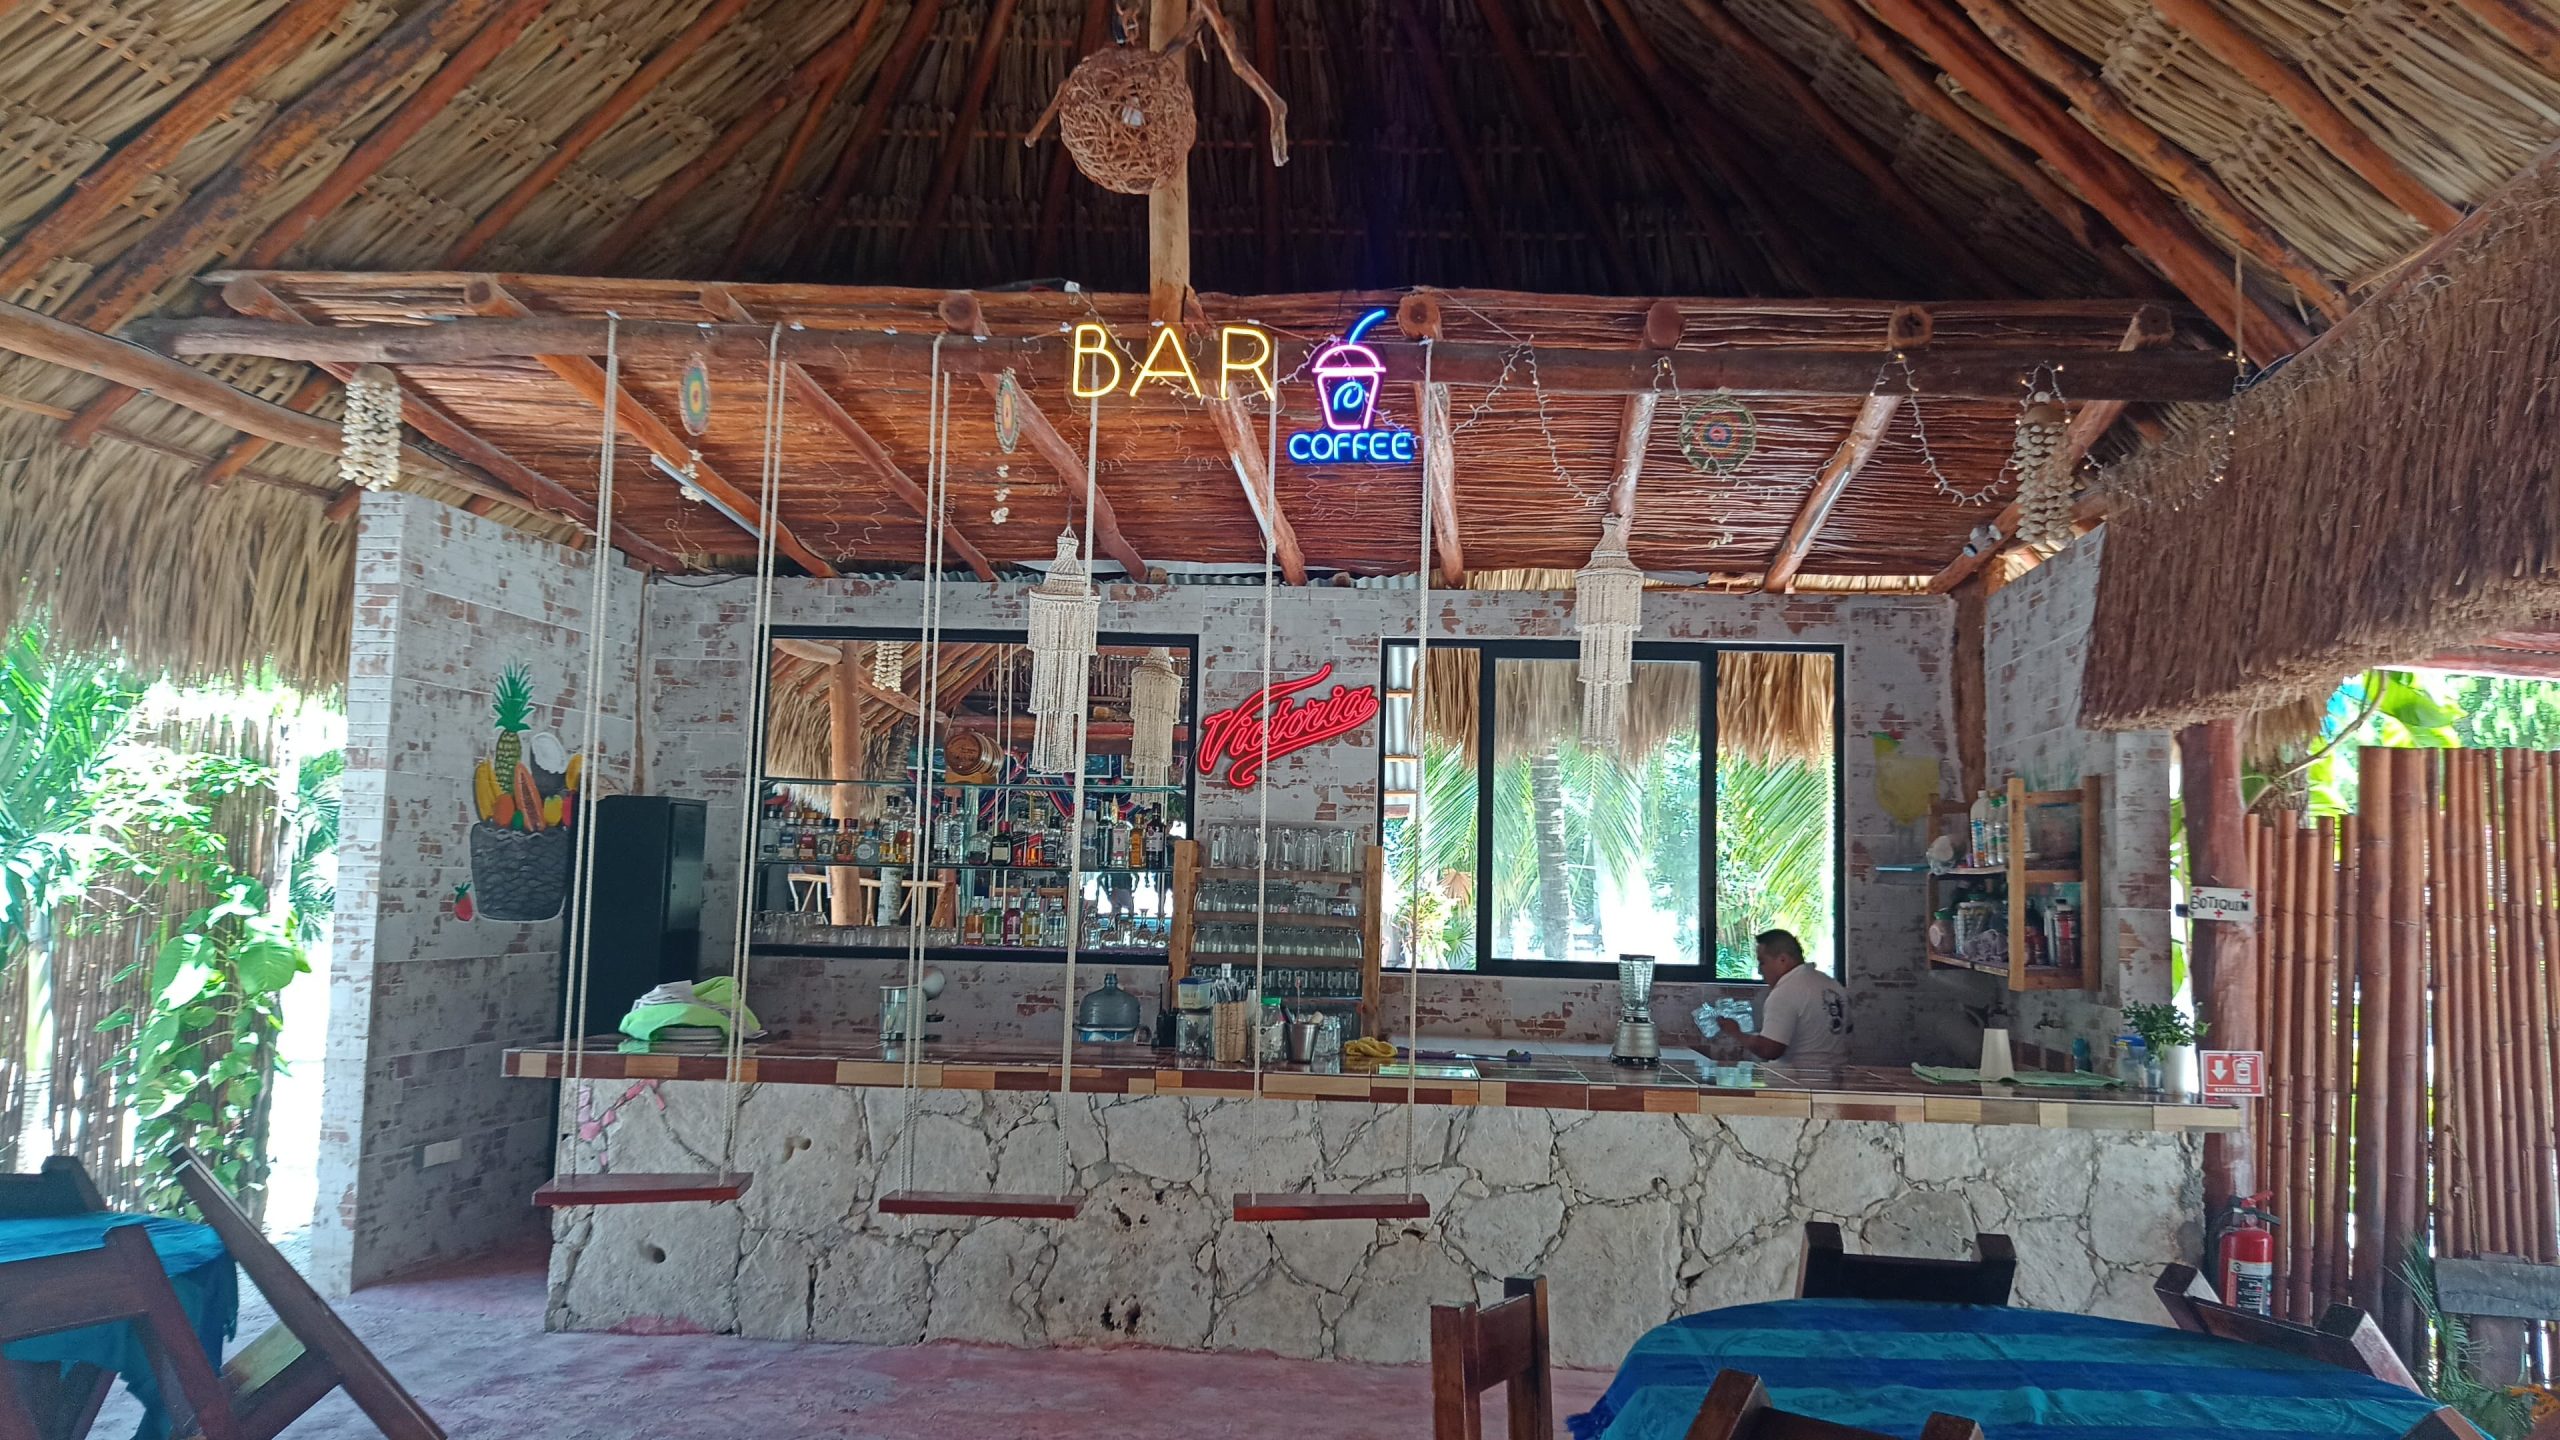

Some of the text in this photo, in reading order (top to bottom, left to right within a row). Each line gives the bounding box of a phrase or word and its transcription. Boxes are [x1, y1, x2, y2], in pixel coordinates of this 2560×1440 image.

[1072, 322, 1276, 402] BAR
[1288, 431, 1414, 462] COFFEE
[1197, 662, 1380, 789] Victoria
